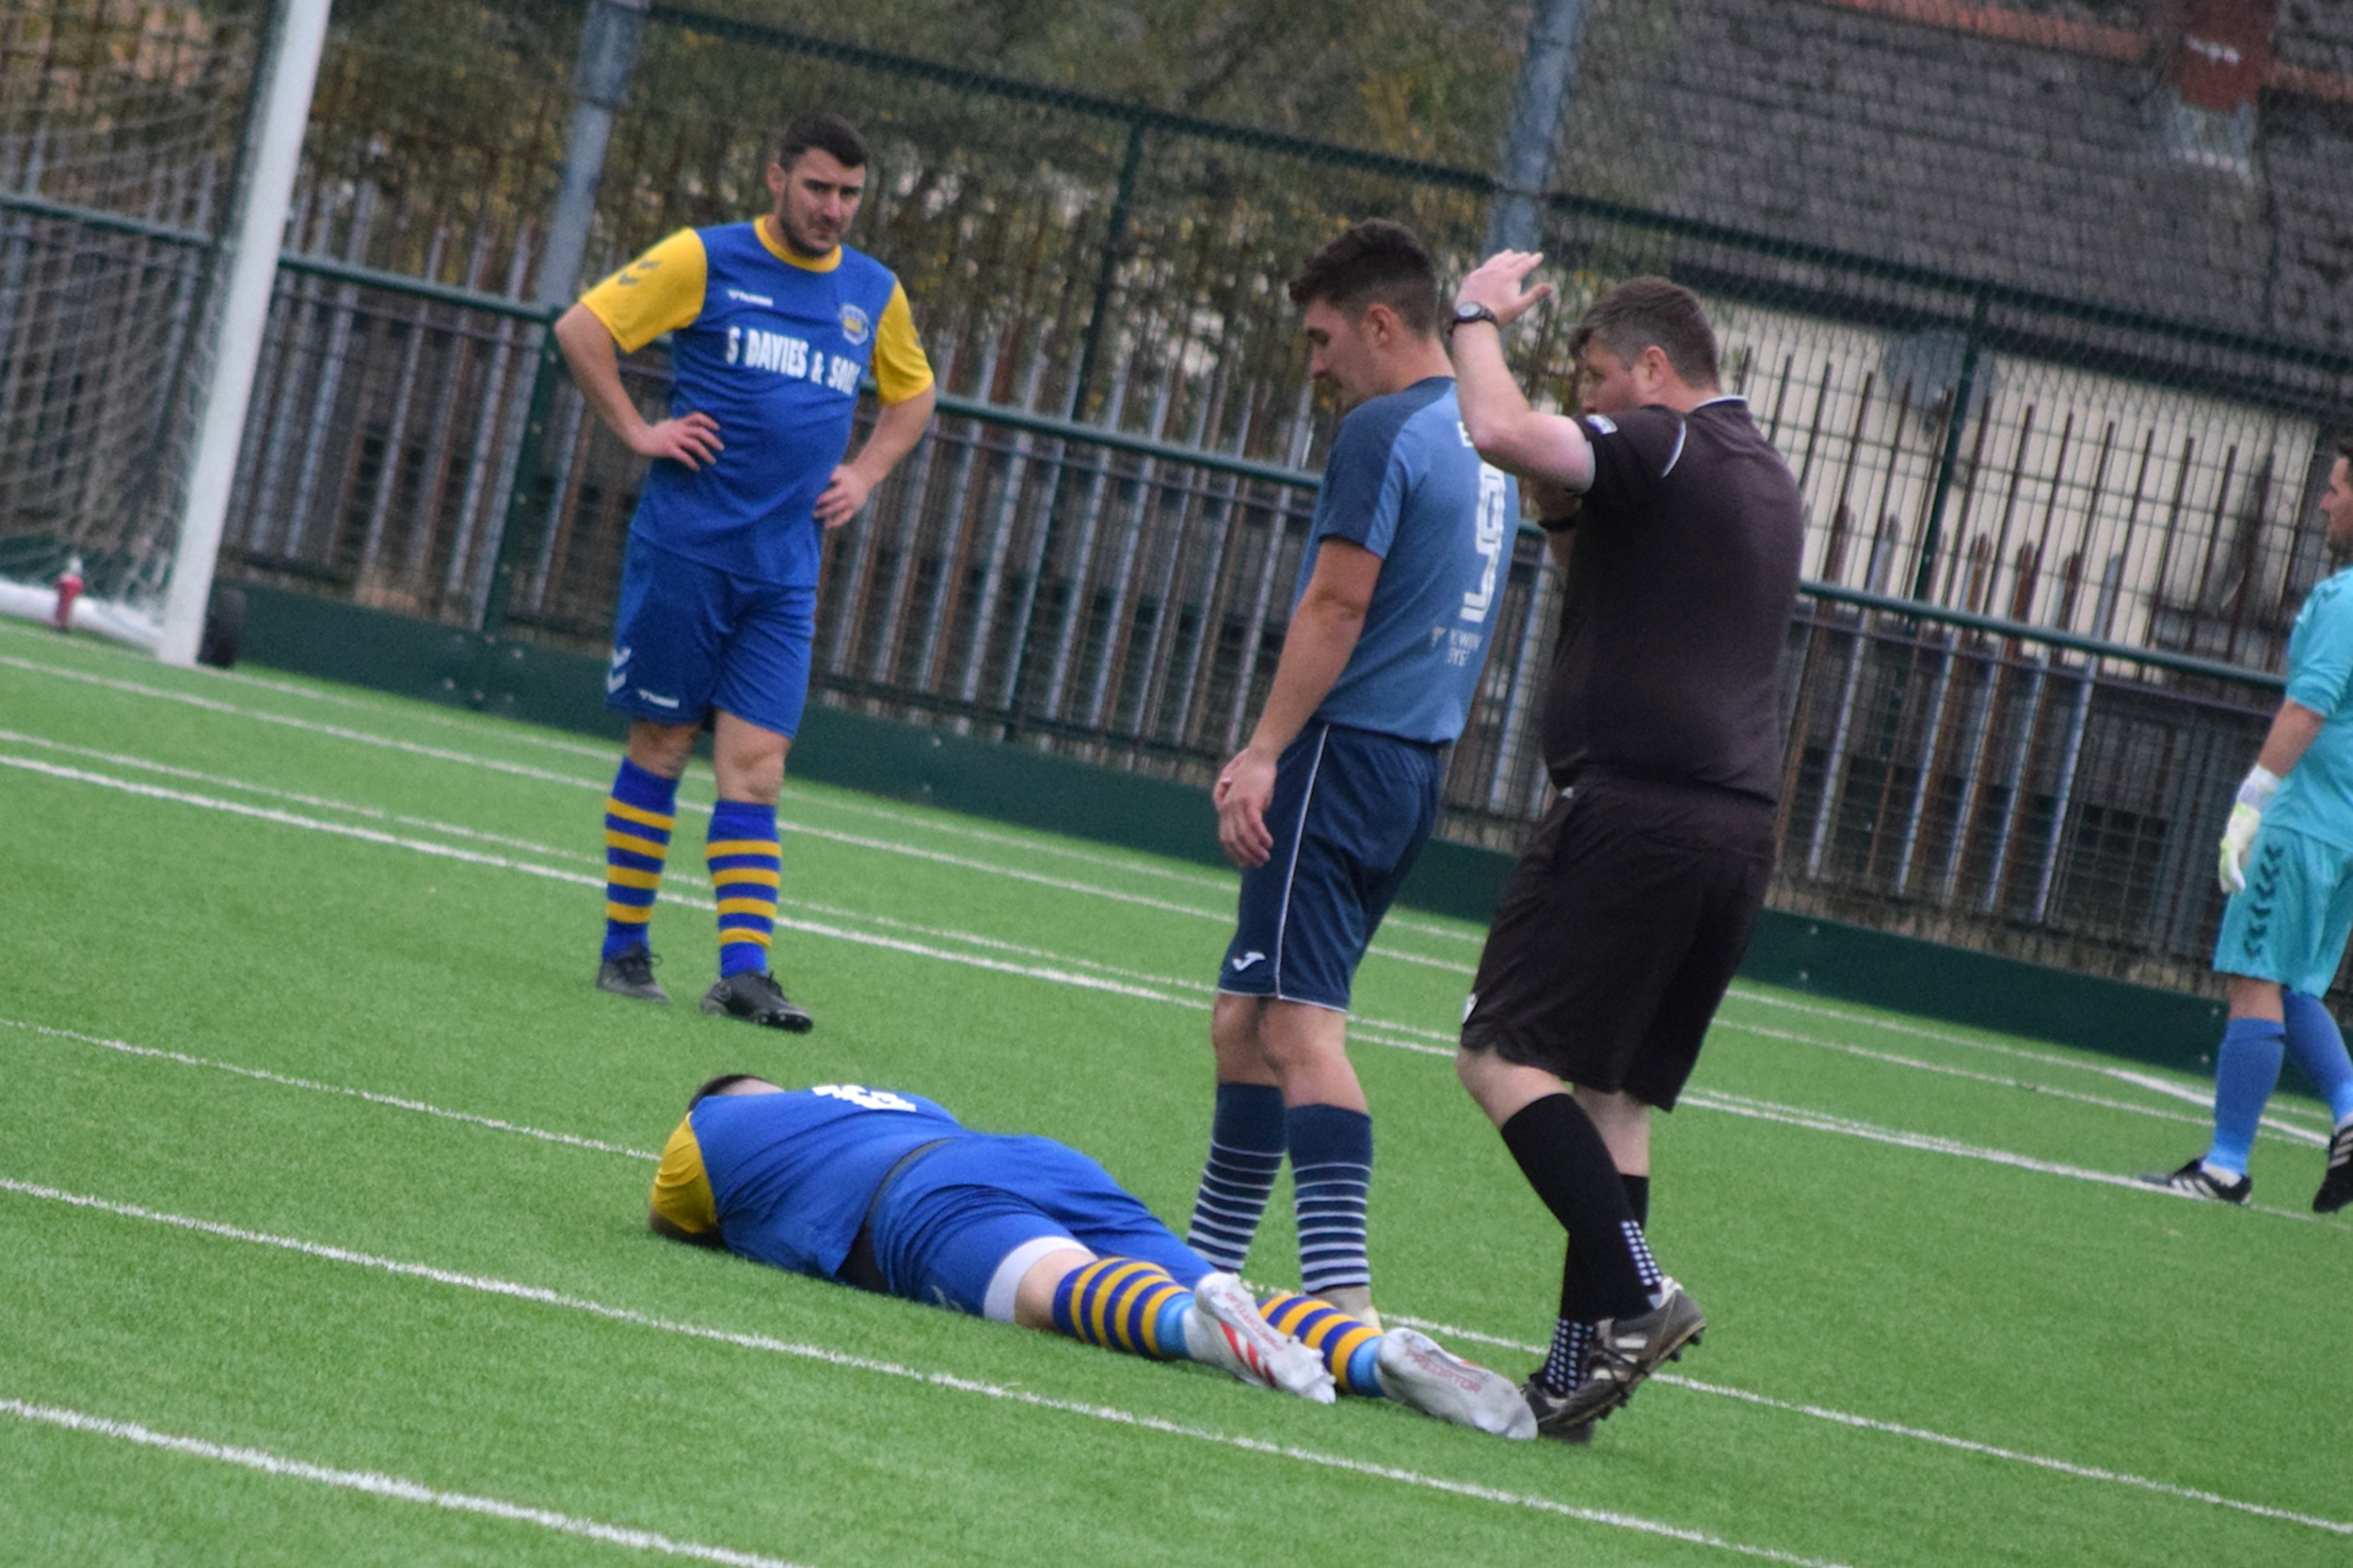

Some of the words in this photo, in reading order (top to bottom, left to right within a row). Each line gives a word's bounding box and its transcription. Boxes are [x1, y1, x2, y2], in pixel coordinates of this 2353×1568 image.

[726, 326, 741, 365] S
[744, 328, 809, 378] DAVIES
[810, 351, 824, 385] &
[1460, 461, 1506, 624] 9
